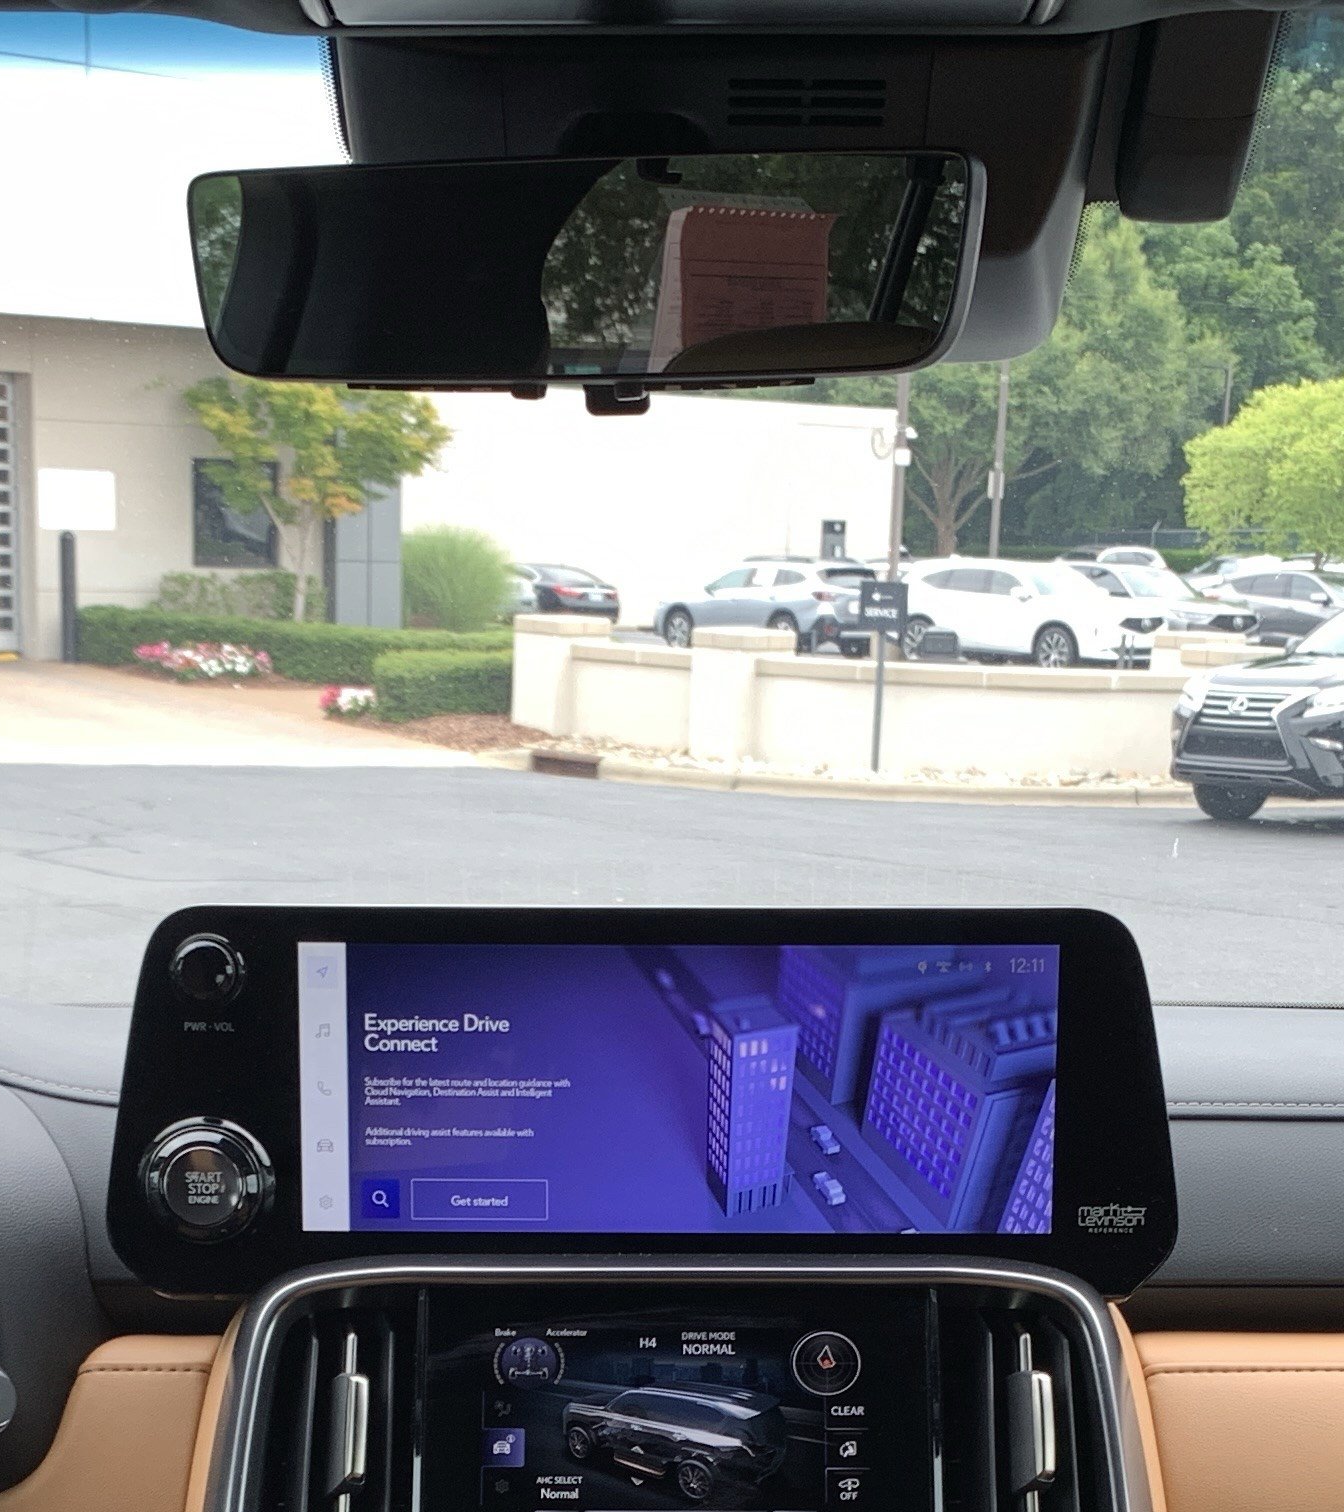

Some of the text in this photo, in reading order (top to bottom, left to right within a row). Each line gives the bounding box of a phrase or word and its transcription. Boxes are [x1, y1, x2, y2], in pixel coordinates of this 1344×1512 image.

[864, 607, 898, 619] SERVICE
[1009, 958, 1046, 975] 12:11
[184, 1021, 236, 1033] PWR VOL
[364, 1013, 511, 1036] Experience Drive
[364, 1033, 439, 1053] Connect
[364, 1077, 571, 1090] Subscribe for the latest route and location guidance with
[364, 1087, 553, 1099] Cloud Navigation, Destination Assist and Intelligent
[364, 1097, 401, 1107] Assistant.
[365, 1127, 535, 1139] Additional driving assist features available with
[365, 1137, 413, 1147] subscription.
[185, 1171, 223, 1183] START
[188, 1182, 220, 1195] STOP
[451, 1195, 509, 1208] Get started
[1078, 1216, 1145, 1227] Levinson
[494, 1328, 587, 1337] Brake Accelerator
[681, 1331, 736, 1341] DRIVE MODE
[639, 1336, 657, 1350] H4
[681, 1343, 736, 1356] NORMAL
[831, 1406, 865, 1417] CLEAR
[536, 1476, 583, 1486] AHC SELECT
[540, 1487, 580, 1501] Normal
[839, 1490, 858, 1501] OFF
